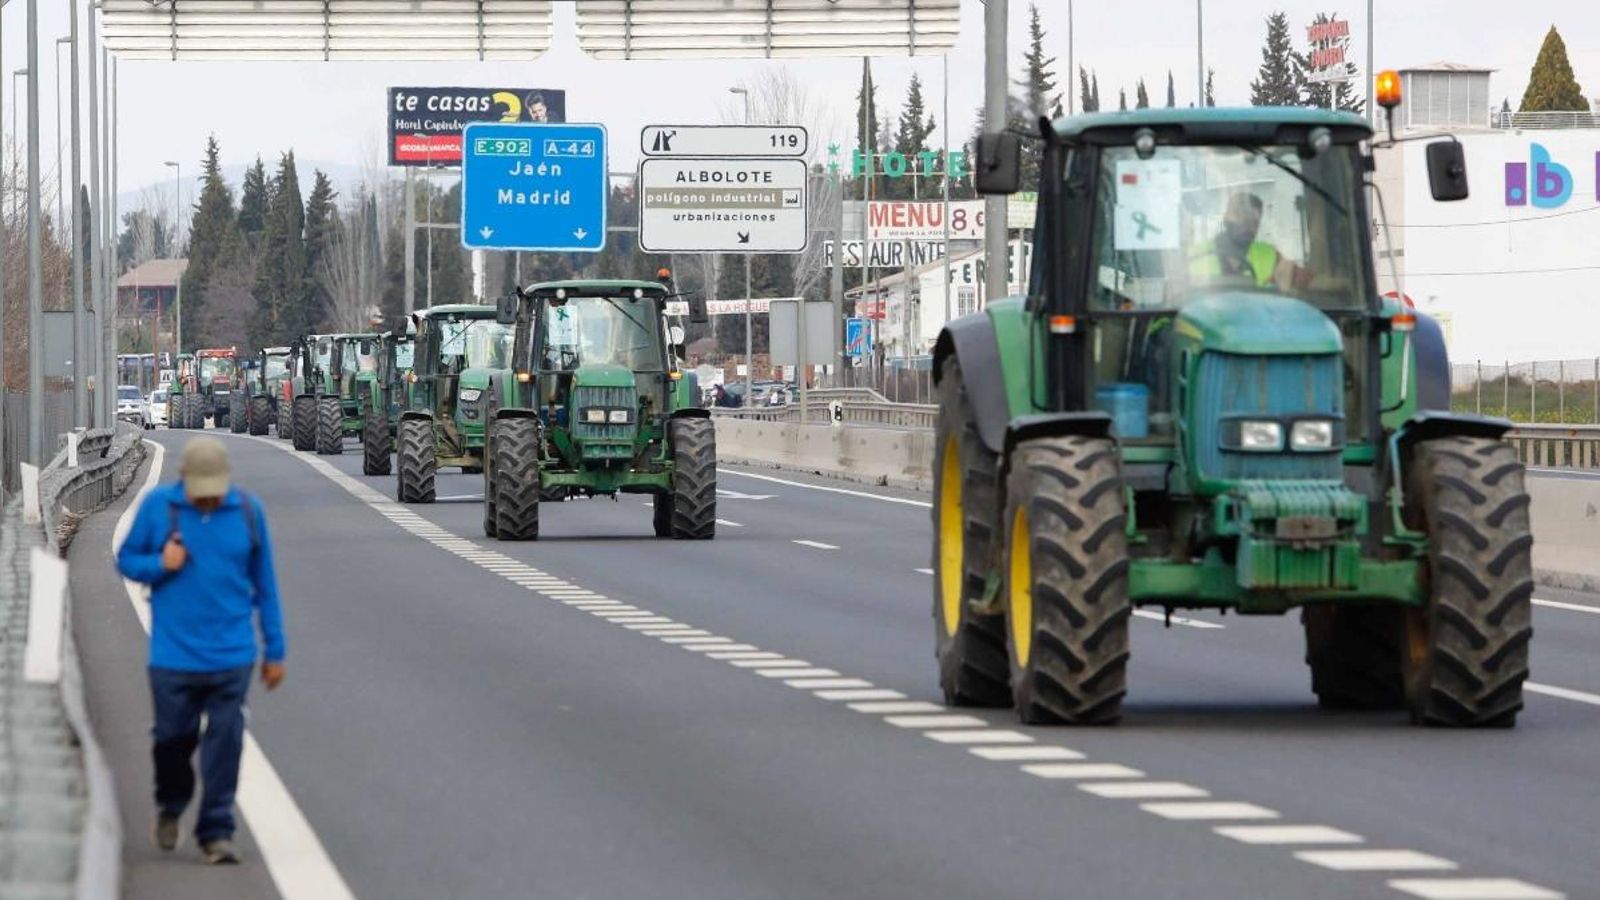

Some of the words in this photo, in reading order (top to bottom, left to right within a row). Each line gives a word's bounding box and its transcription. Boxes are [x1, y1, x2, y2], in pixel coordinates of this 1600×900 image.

[395, 92, 418, 112] te
[477, 140, 529, 153] E-902
[770, 134, 798, 147] 119
[546, 142, 593, 154] A-44
[509, 161, 562, 176] Jaén
[853, 149, 968, 177] HOTE
[675, 171, 773, 183] ALBOLOTE
[497, 189, 571, 205] Madrid
[647, 191, 706, 205] polígono
[711, 192, 776, 203] industrial
[673, 212, 776, 222] urbanizaciones
[869, 203, 943, 228] MENU
